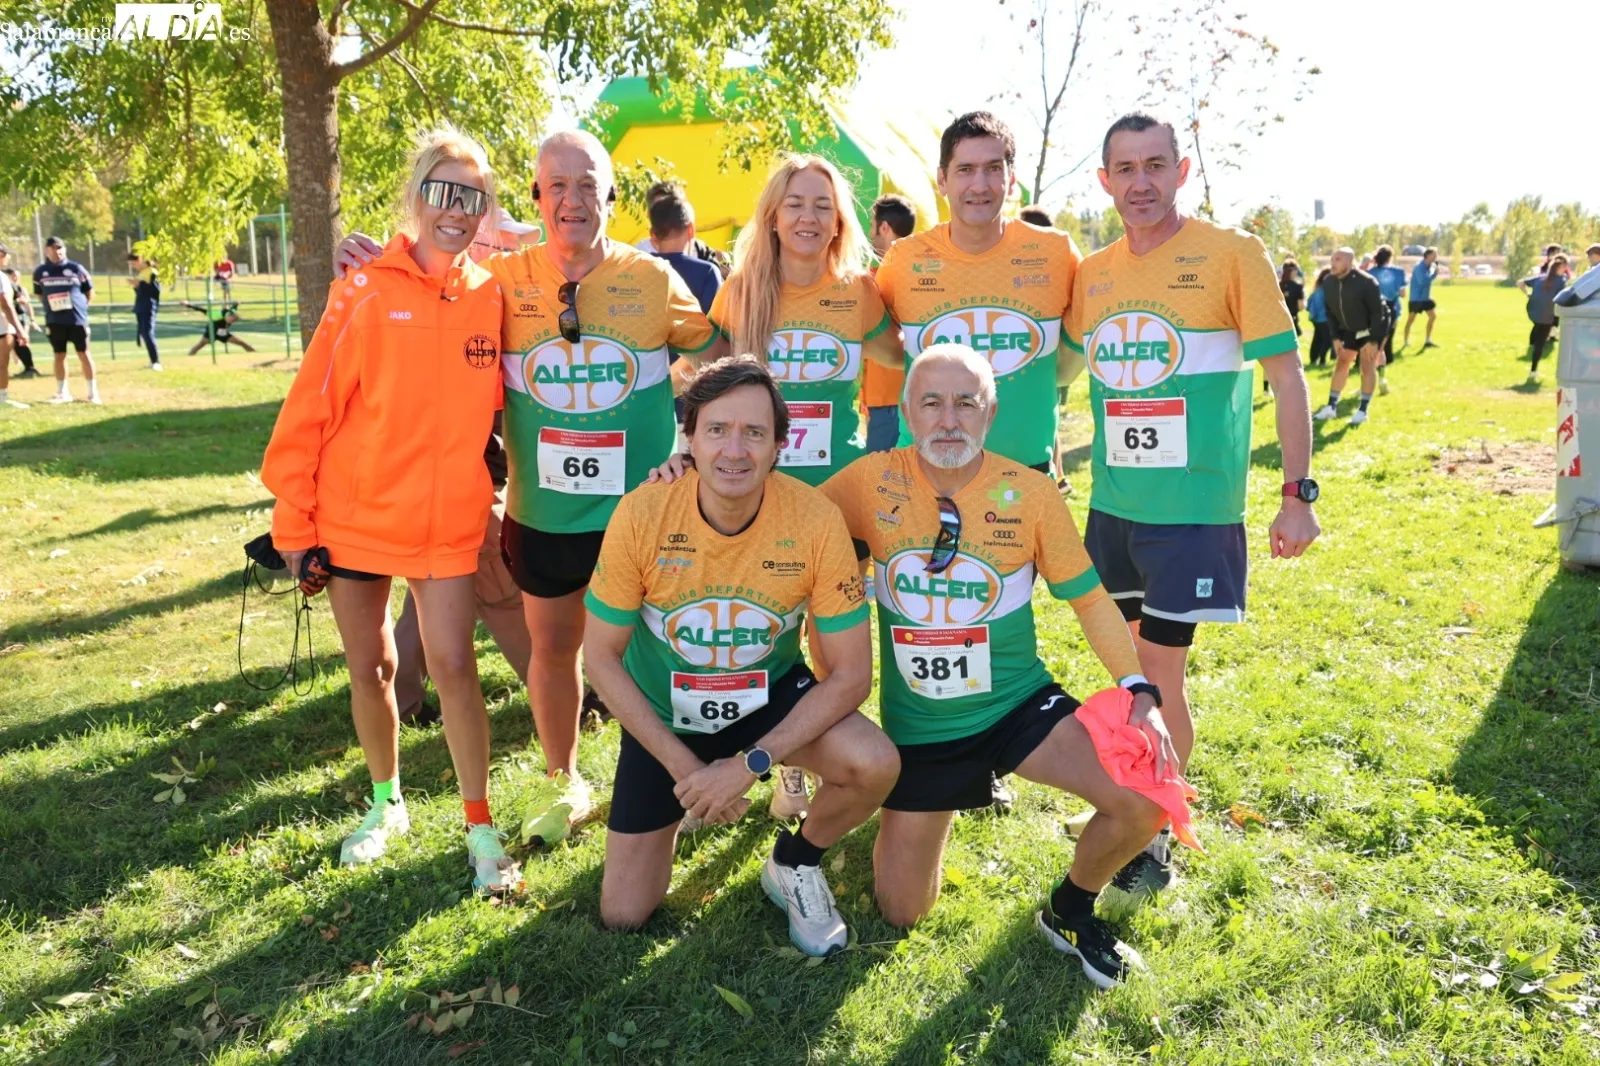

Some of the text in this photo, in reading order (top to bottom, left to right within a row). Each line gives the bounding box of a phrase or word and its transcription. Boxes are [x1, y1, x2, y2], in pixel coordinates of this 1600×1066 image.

[389, 311, 412, 320] JAKO
[918, 296, 1042, 322] CLUB DEPORTIVO
[1117, 299, 1186, 327] DEPORTIVO
[520, 328, 551, 351] CLUB
[1094, 340, 1171, 365] ALCER
[532, 362, 629, 385] ALCER
[1124, 427, 1159, 450] 63
[563, 456, 600, 478] 66
[885, 537, 914, 555] CLUB
[661, 584, 788, 614] CLUB DEPORTIVO
[894, 572, 990, 603] ALCER
[673, 625, 773, 648] ALCER
[911, 655, 969, 681] 381
[701, 700, 740, 720] 68
